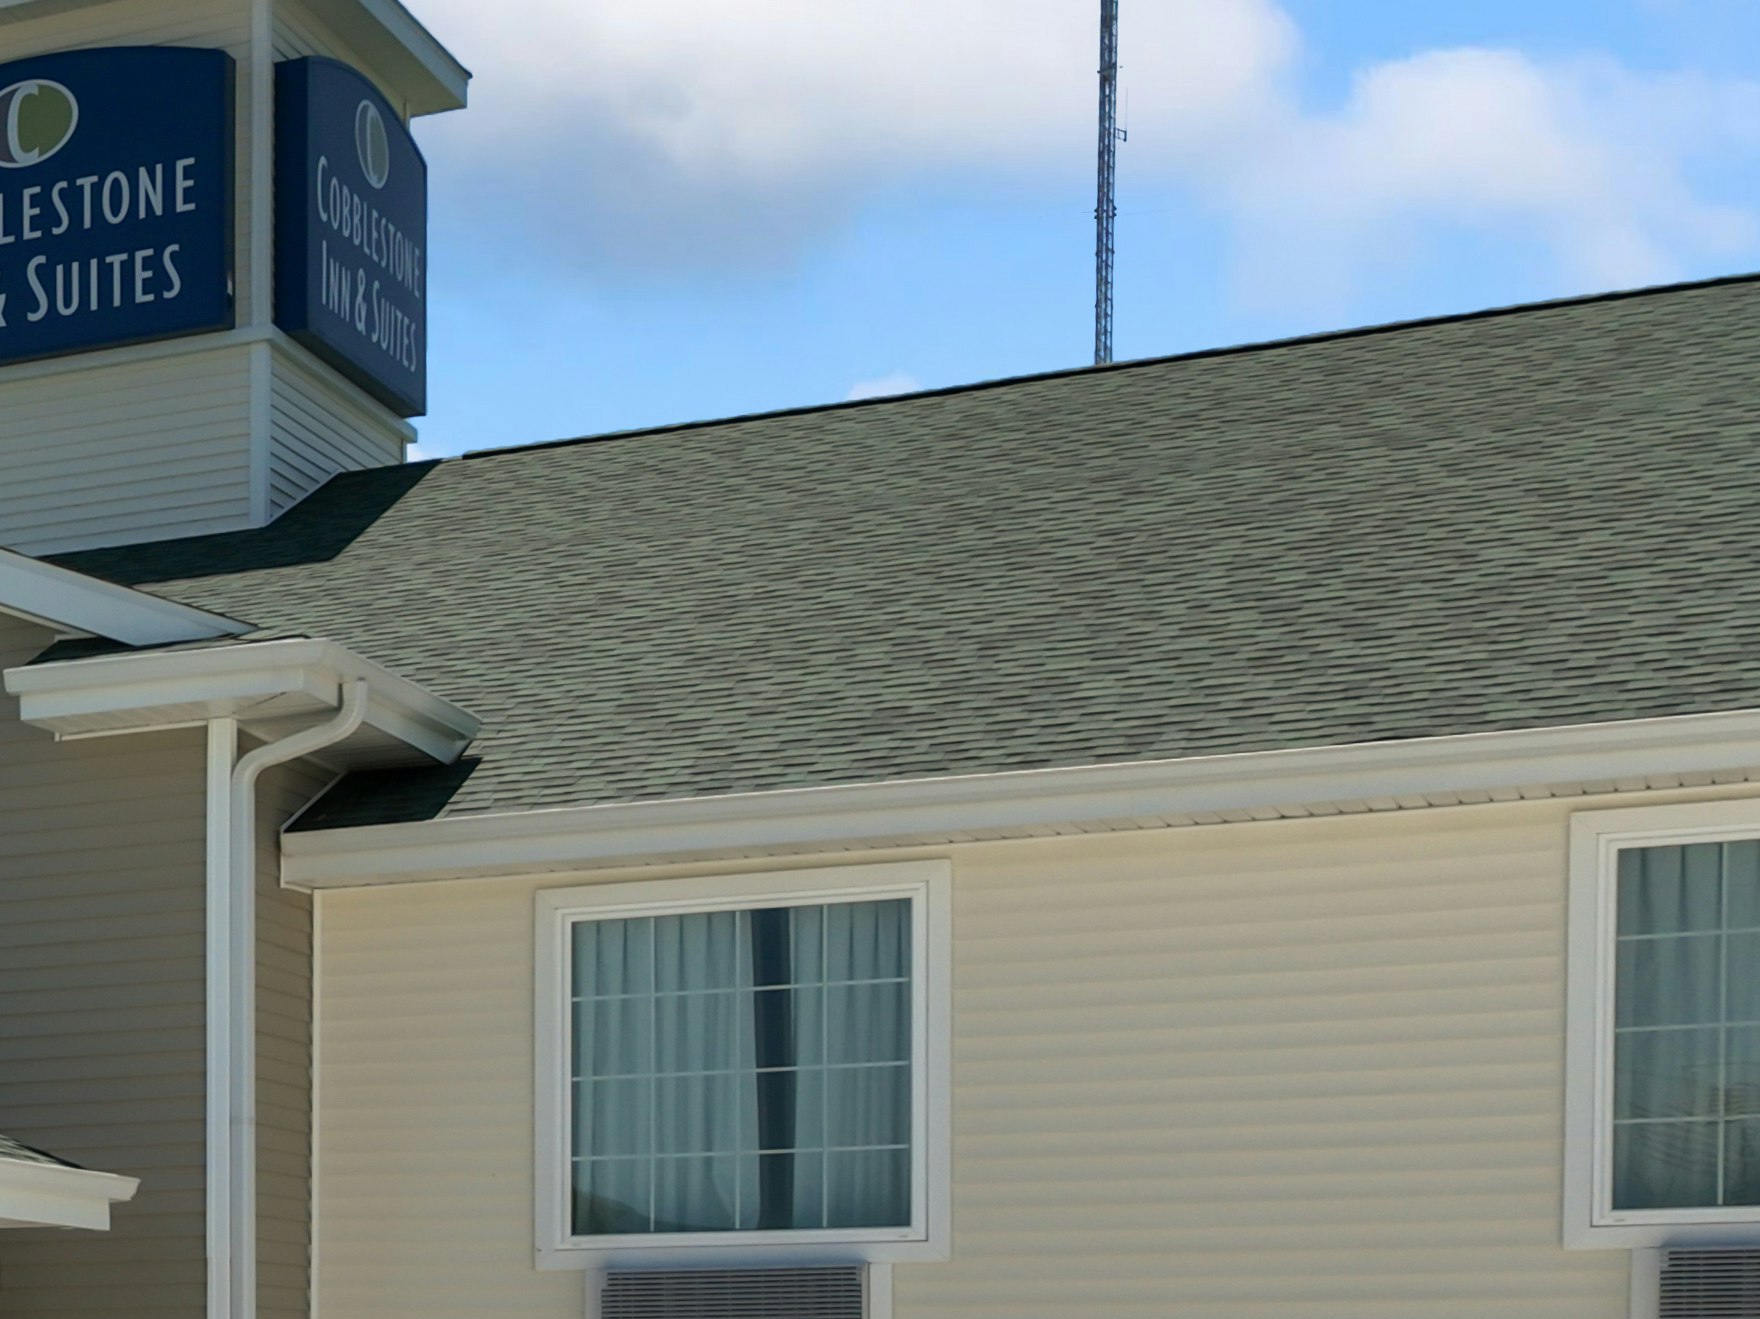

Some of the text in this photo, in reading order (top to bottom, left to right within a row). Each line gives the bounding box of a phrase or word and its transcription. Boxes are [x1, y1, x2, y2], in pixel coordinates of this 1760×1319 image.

[26, 243, 181, 322] SUITES
[317, 155, 421, 299] COBBLESTONE
[321, 239, 418, 373] INN & SUITES
